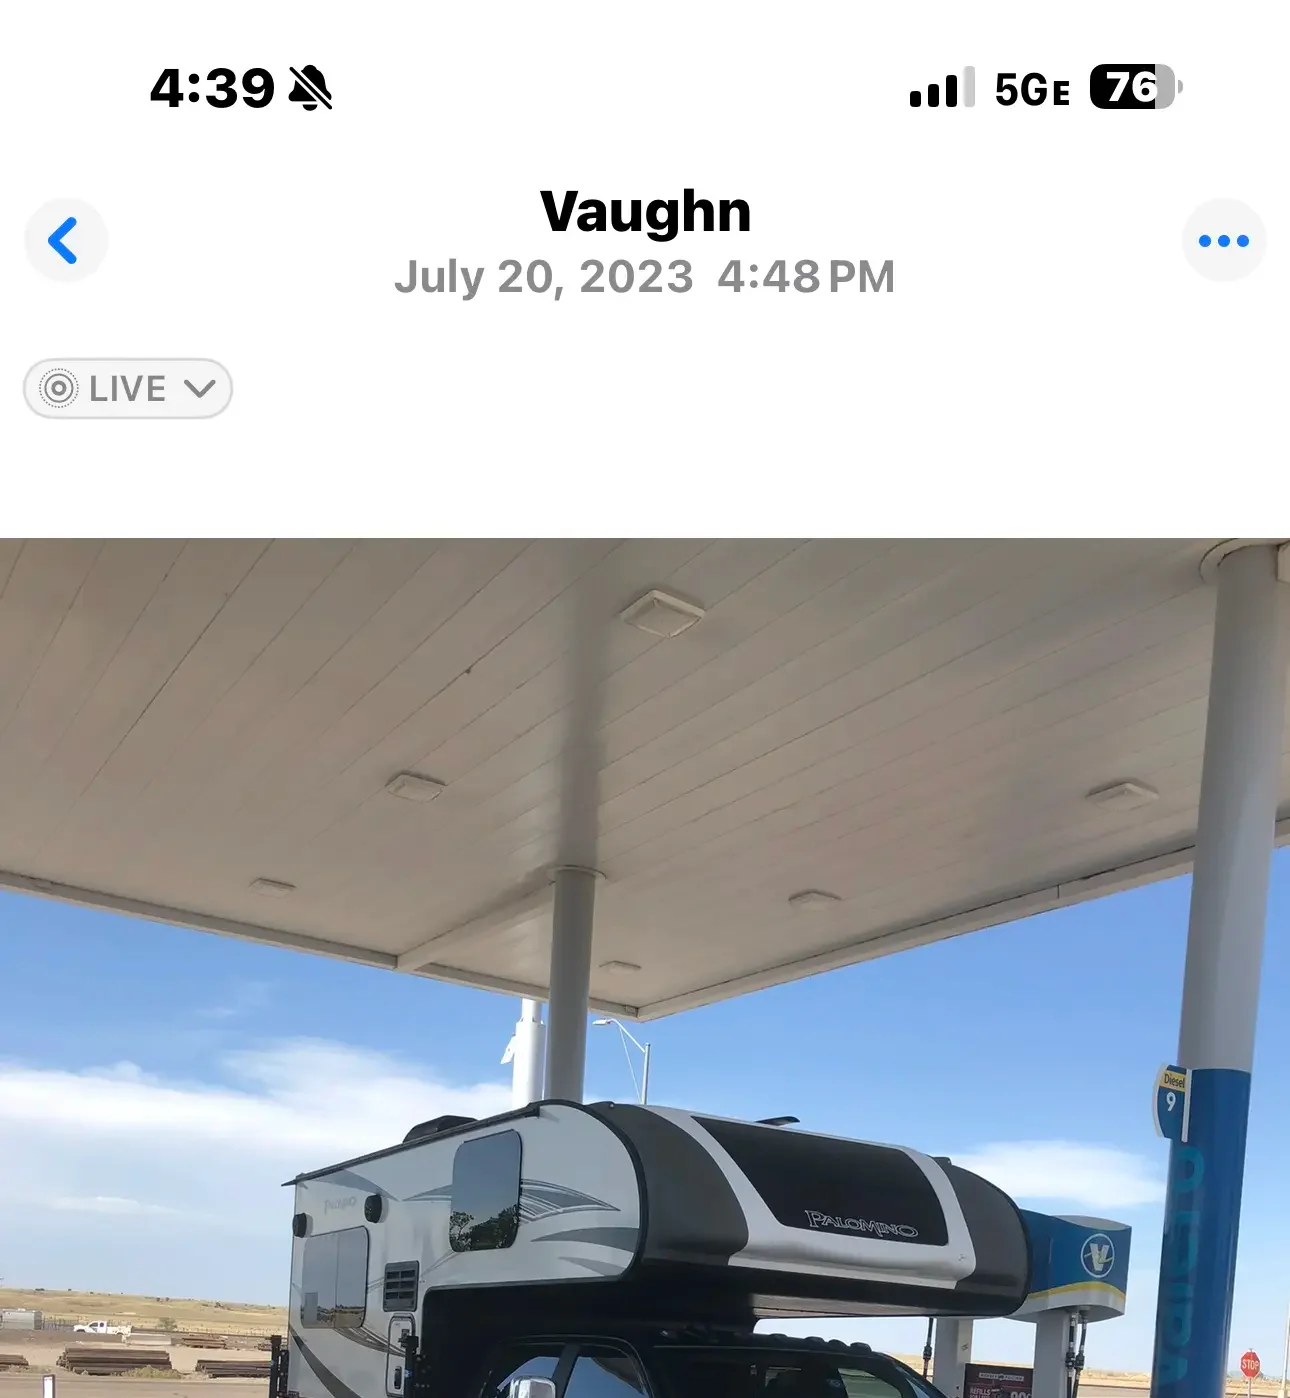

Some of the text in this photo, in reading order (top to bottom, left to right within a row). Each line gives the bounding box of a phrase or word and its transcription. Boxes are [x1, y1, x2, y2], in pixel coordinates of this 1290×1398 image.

[1163, 1073, 1186, 1089] Diesel
[1166, 1091, 1176, 1112] 9
[1241, 1358, 1260, 1371] STOP
